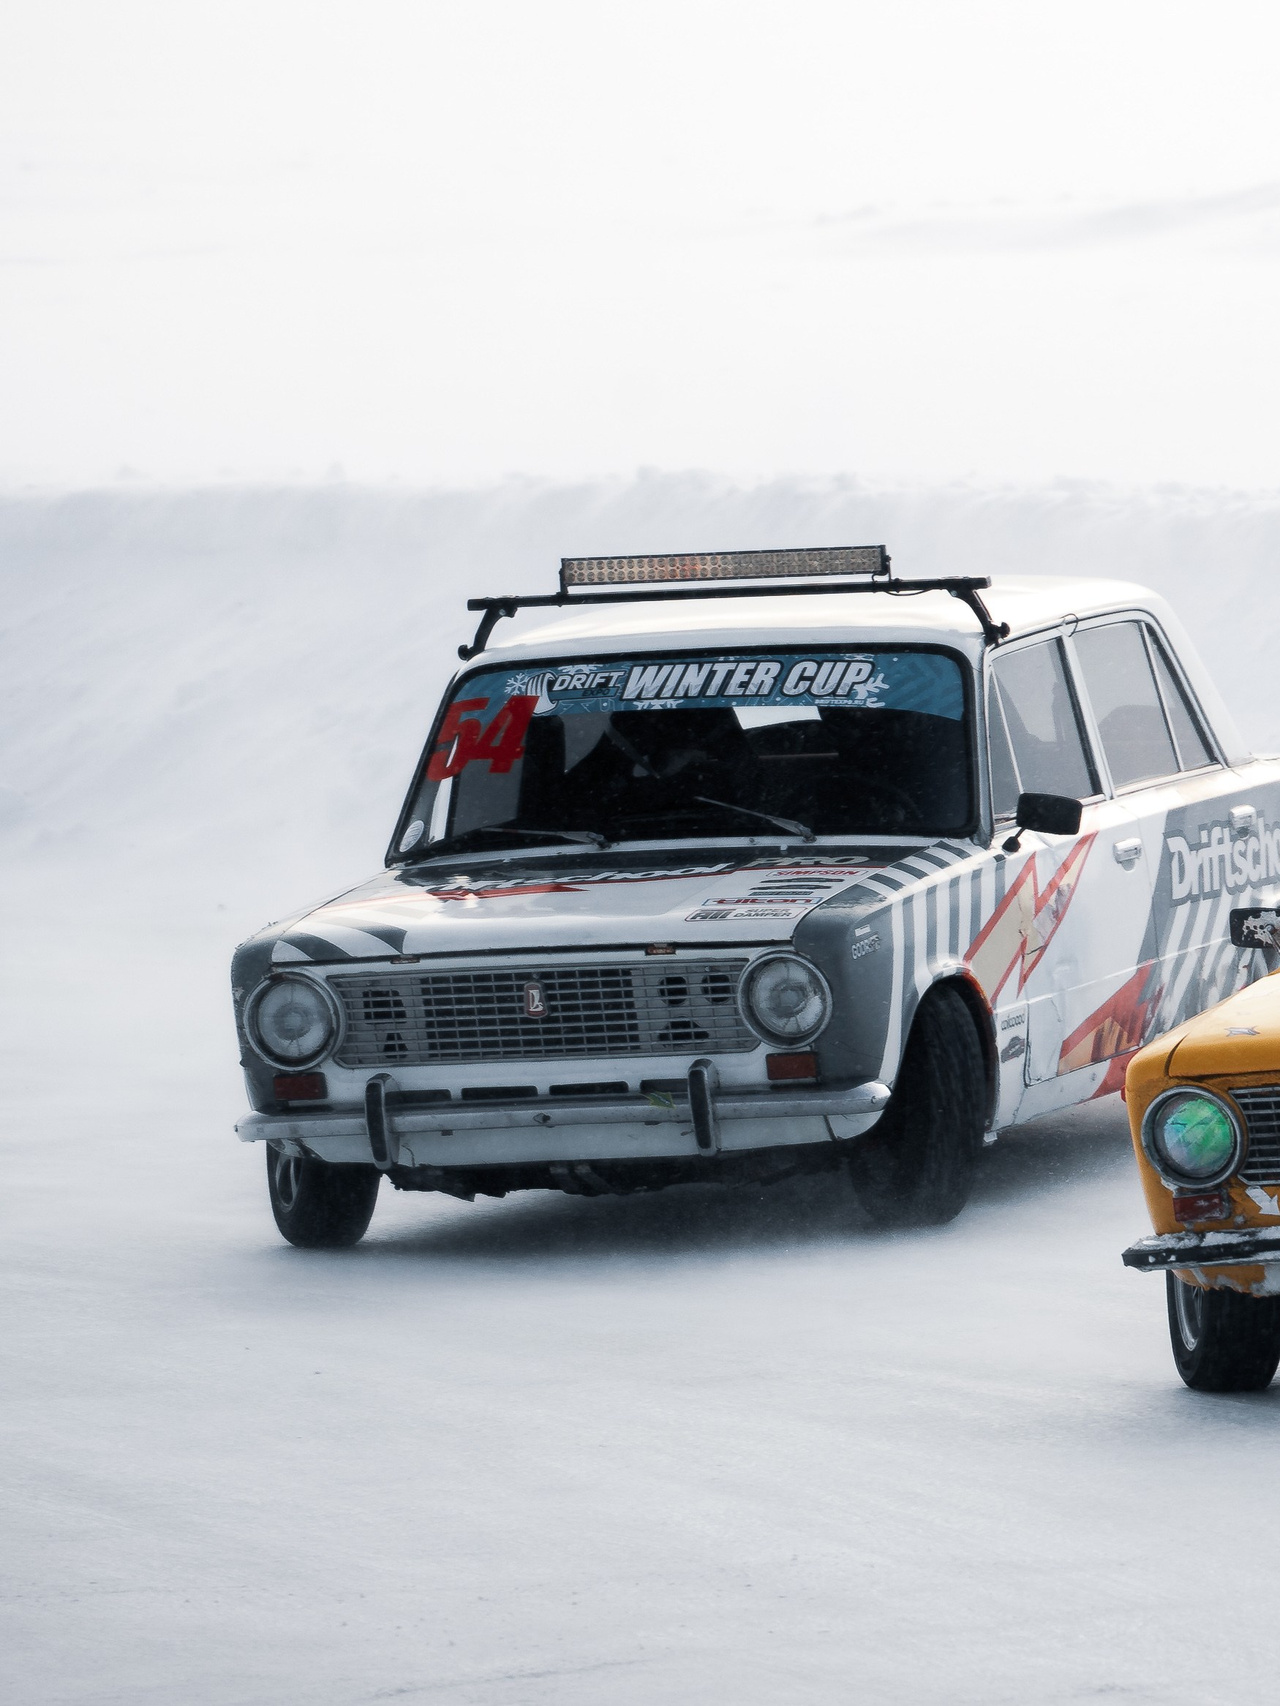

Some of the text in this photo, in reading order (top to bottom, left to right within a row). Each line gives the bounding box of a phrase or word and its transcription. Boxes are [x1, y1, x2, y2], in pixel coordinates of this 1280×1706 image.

[552, 670, 627, 691] DRIFT
[621, 661, 874, 700] WINTER CUP
[581, 688, 611, 698] EXPO
[426, 695, 540, 783] 54
[747, 856, 870, 867] PRO
